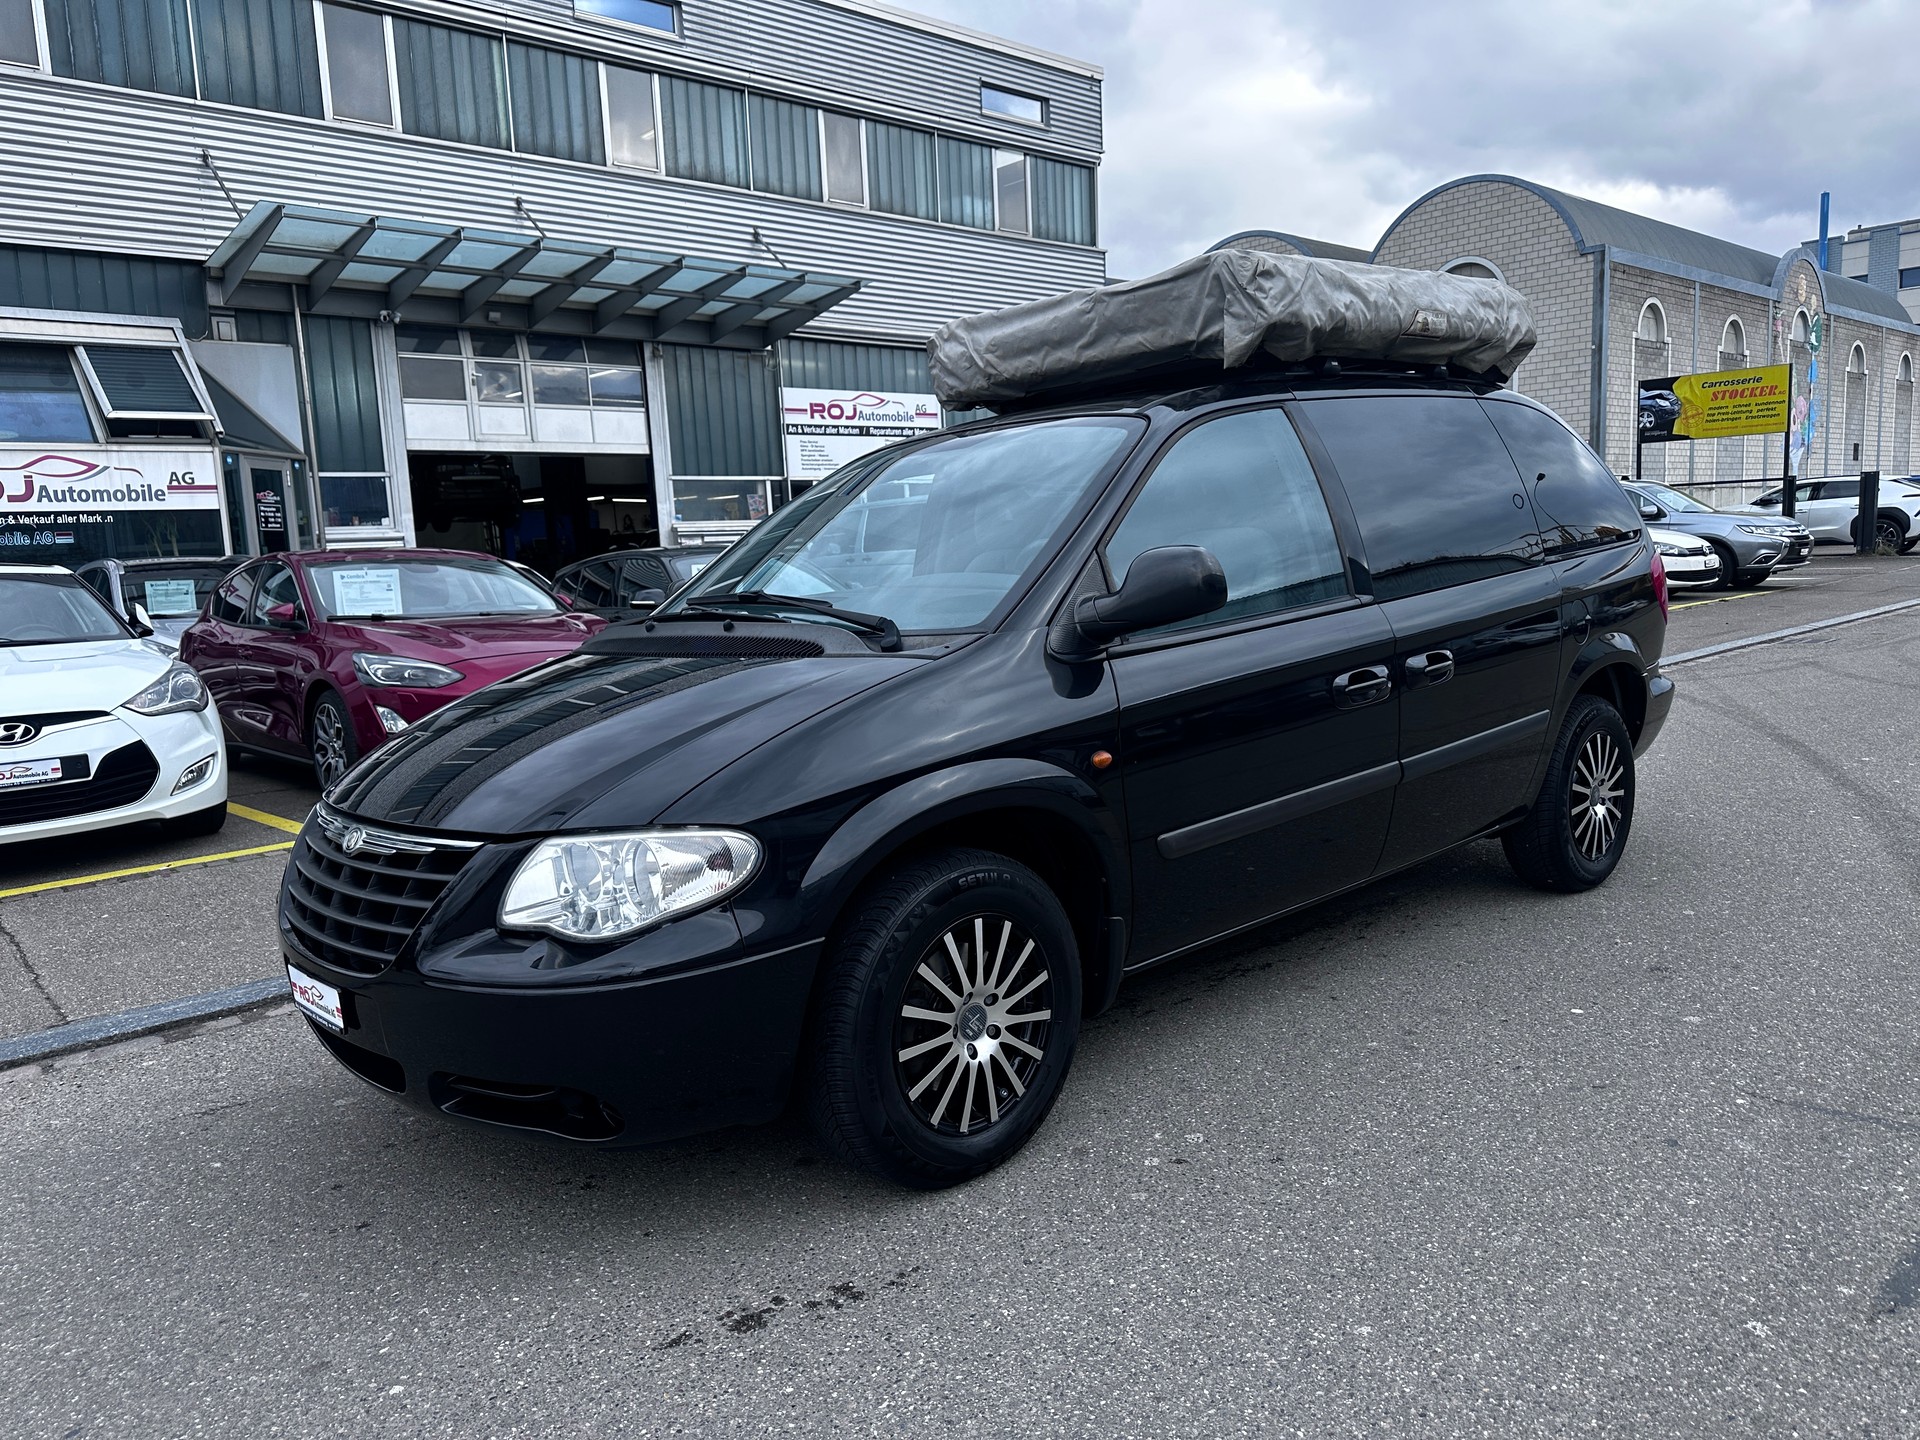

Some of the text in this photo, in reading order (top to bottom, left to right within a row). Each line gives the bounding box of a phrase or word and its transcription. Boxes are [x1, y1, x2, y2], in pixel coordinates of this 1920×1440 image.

[1711, 385, 1778, 401] STOCKER
[809, 402, 927, 423] ROJ Automobile AG
[788, 425, 797, 433] An
[798, 425, 802, 433] &
[803, 425, 825, 434] Verkauf
[826, 426, 838, 434] aller
[839, 426, 860, 435] Marken
[870, 427, 902, 437] Reparaturen
[902, 428, 914, 436] aller
[37, 484, 166, 503] Automobile
[168, 471, 195, 485] AG
[8, 514, 15, 525] &
[17, 514, 54, 525] Verkauf
[57, 514, 77, 523] aller
[0, 530, 54, 546] obile AG
